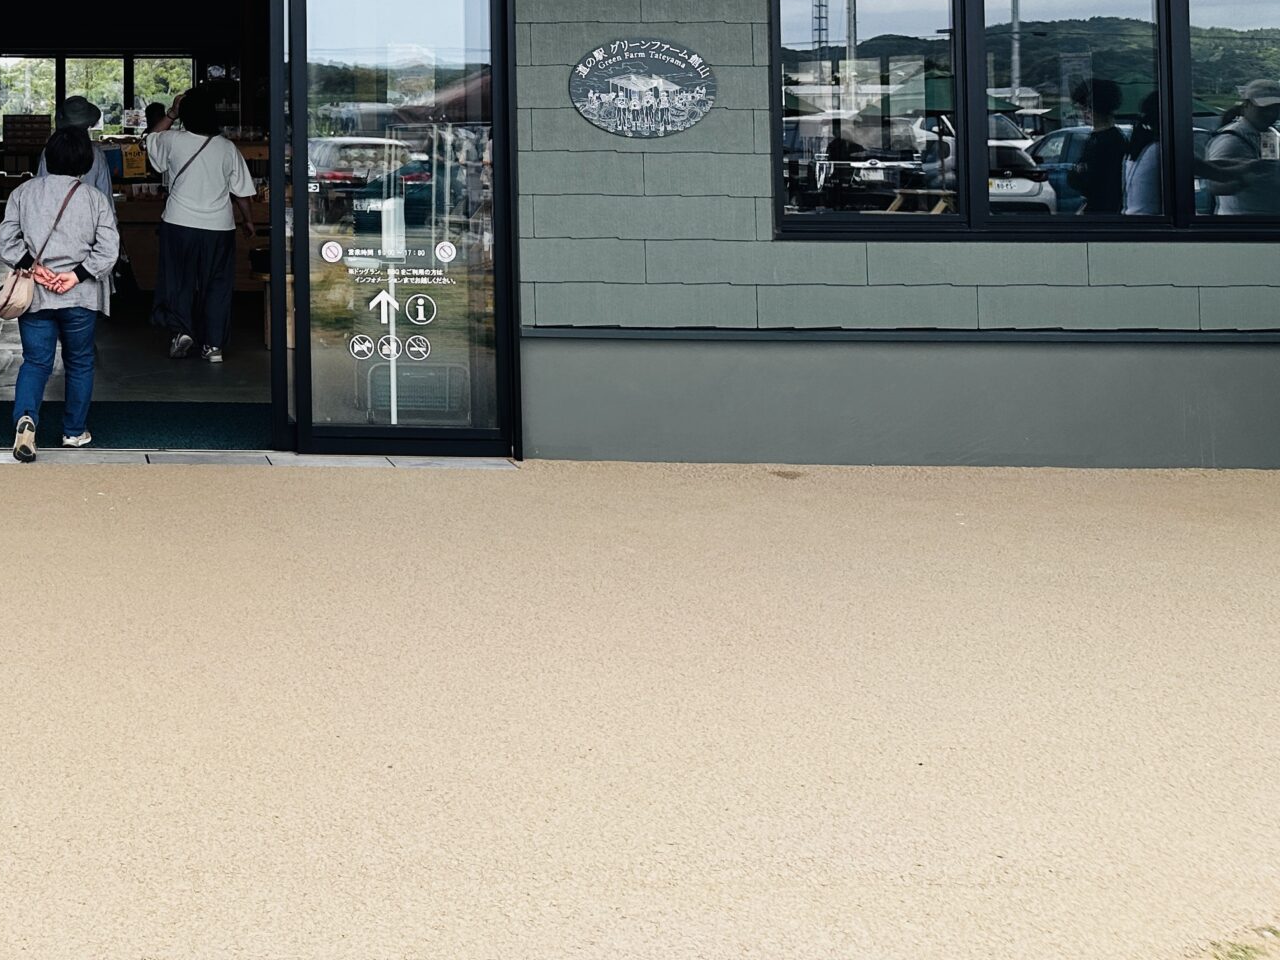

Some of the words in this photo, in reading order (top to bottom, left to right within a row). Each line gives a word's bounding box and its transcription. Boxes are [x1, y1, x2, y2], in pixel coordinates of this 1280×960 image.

[575, 47, 609, 79] 道の駅
[598, 55, 623, 70] Green
[624, 51, 646, 60] Farm
[648, 51, 687, 69] Tateyama
